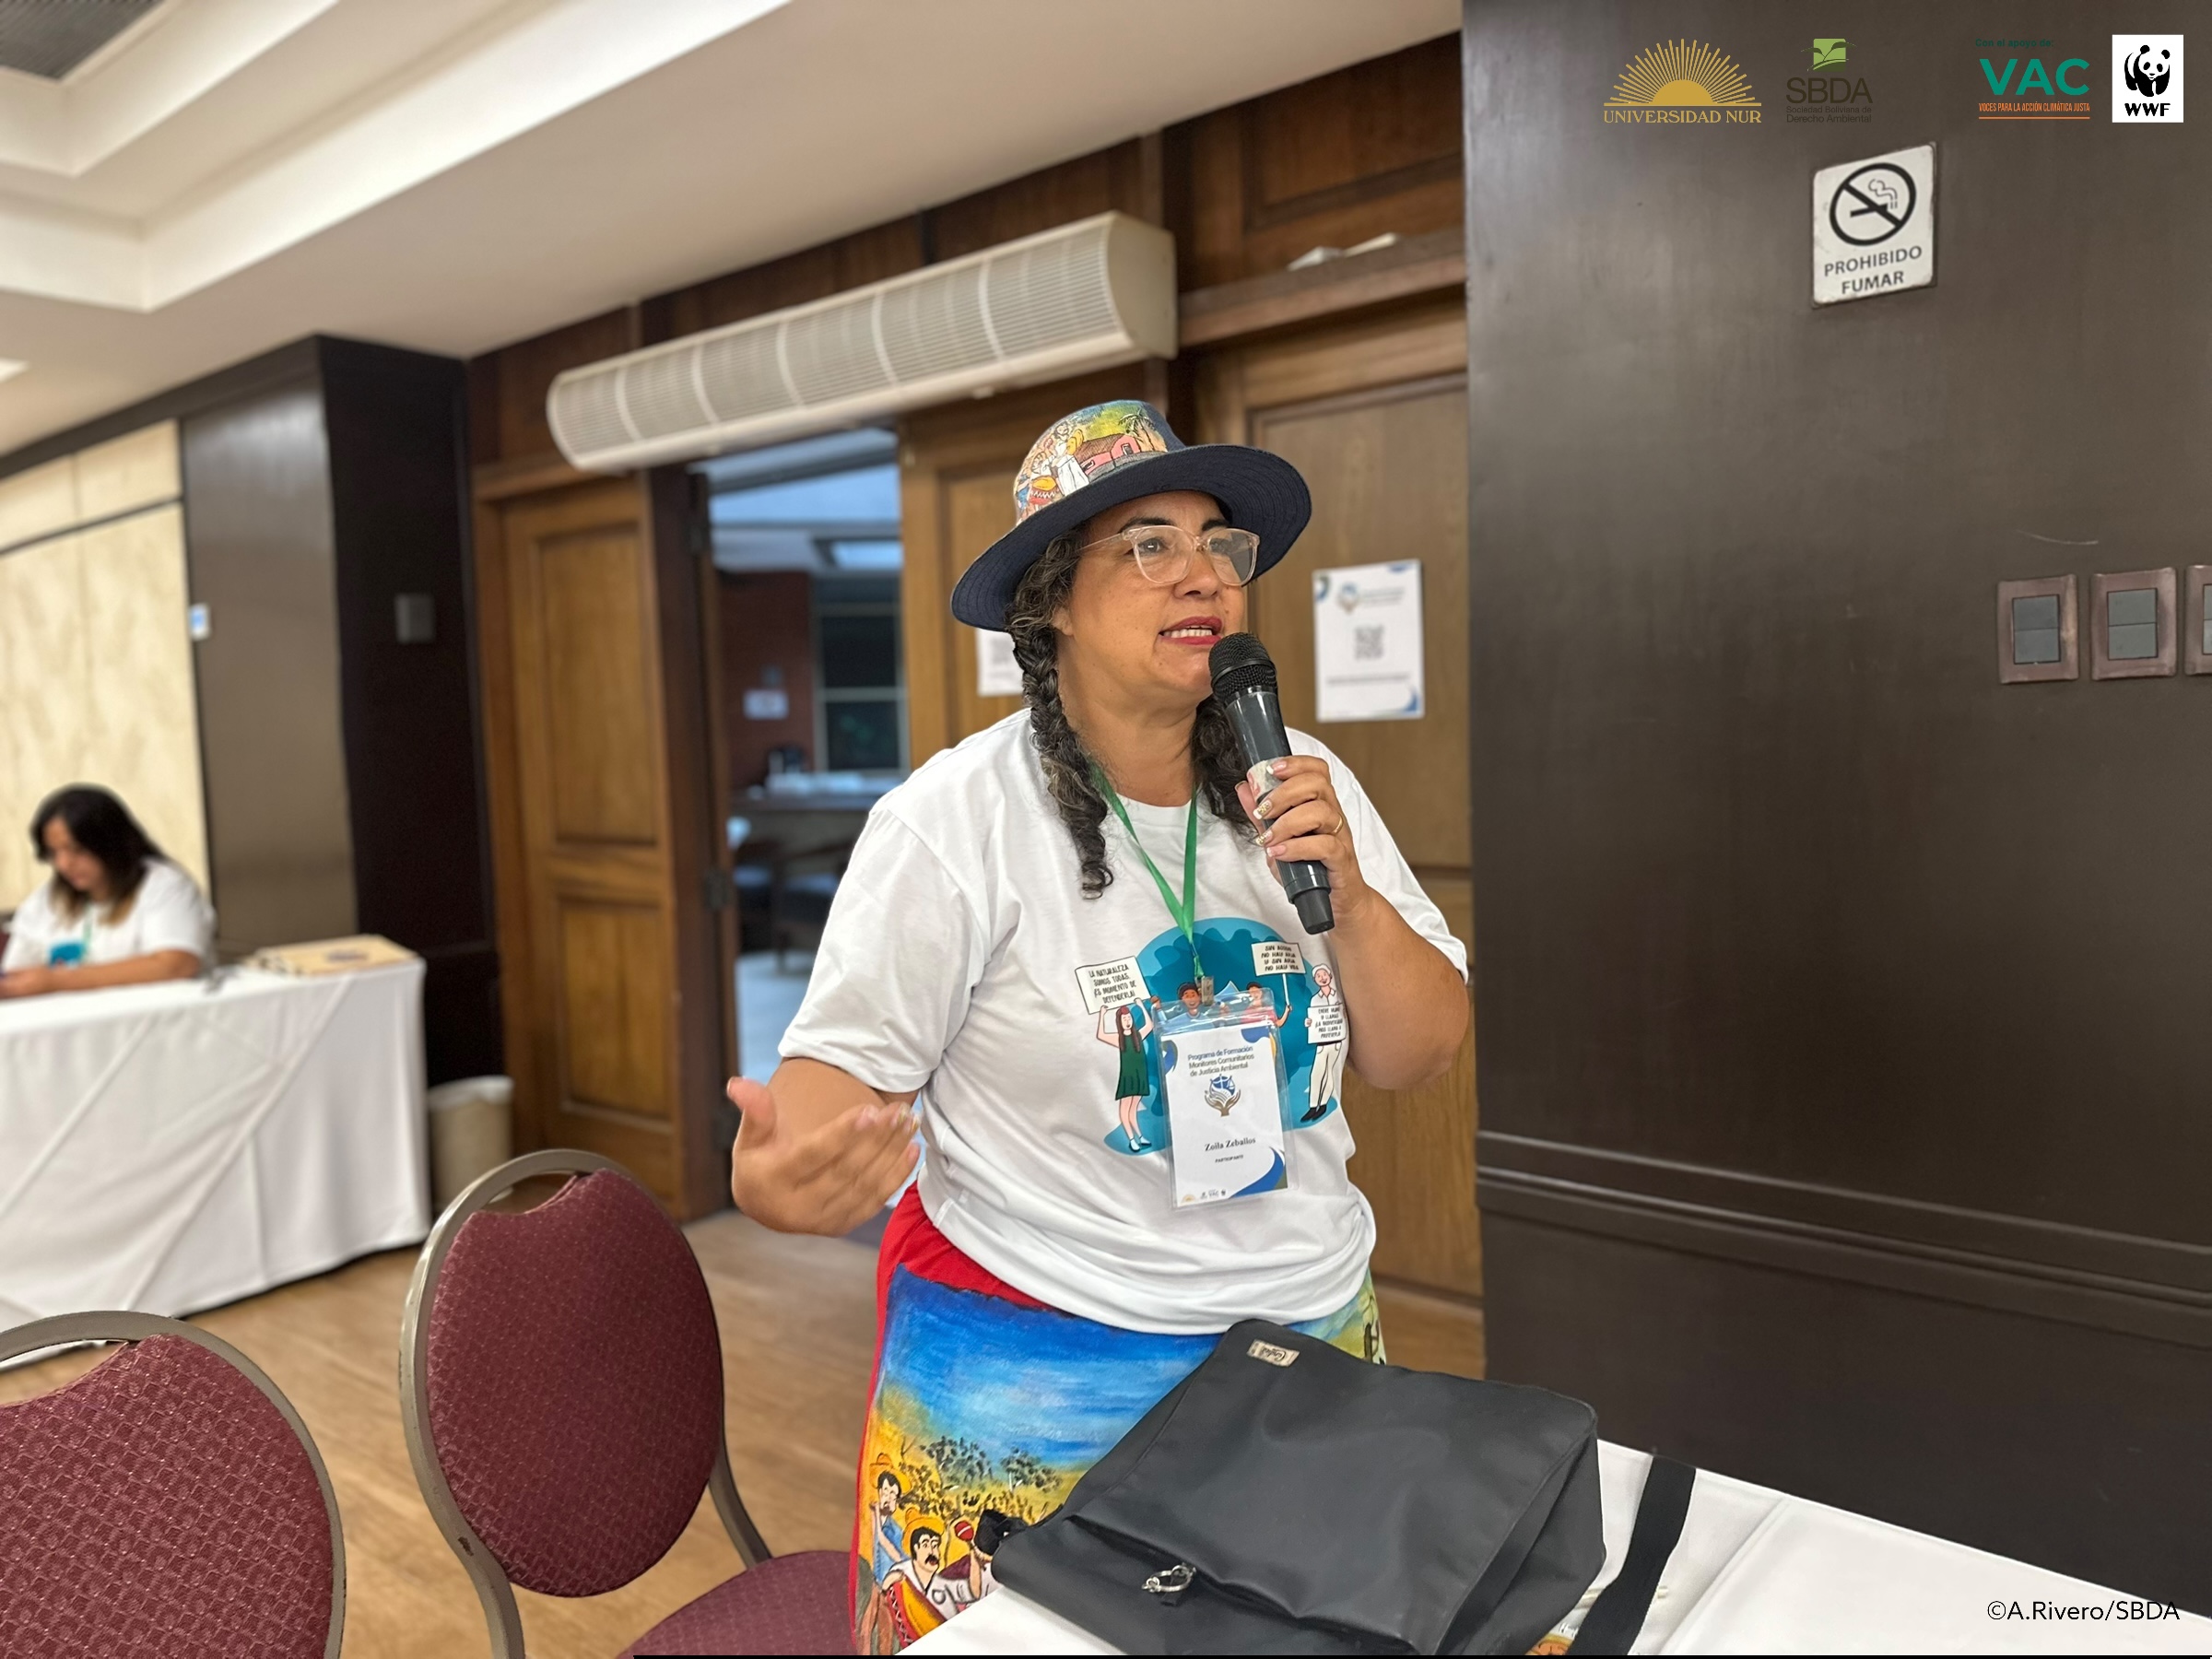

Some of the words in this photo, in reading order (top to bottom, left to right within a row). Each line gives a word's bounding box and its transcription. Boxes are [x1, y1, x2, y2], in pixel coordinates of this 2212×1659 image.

[1824, 245, 1923, 277] PROHIBIDO
[1841, 270, 1904, 295] FUMAR
[1187, 1052, 1216, 1061] Programa
[1223, 1045, 1253, 1055] Formación
[1189, 1059, 1217, 1069] Monitores
[1218, 1053, 1254, 1065] Comunitarios
[1198, 1067, 1219, 1077] Justicia
[1220, 1062, 1248, 1072] Ambiental
[1204, 1142, 1224, 1152] Zoila
[1225, 1137, 1256, 1148] Zeballos
